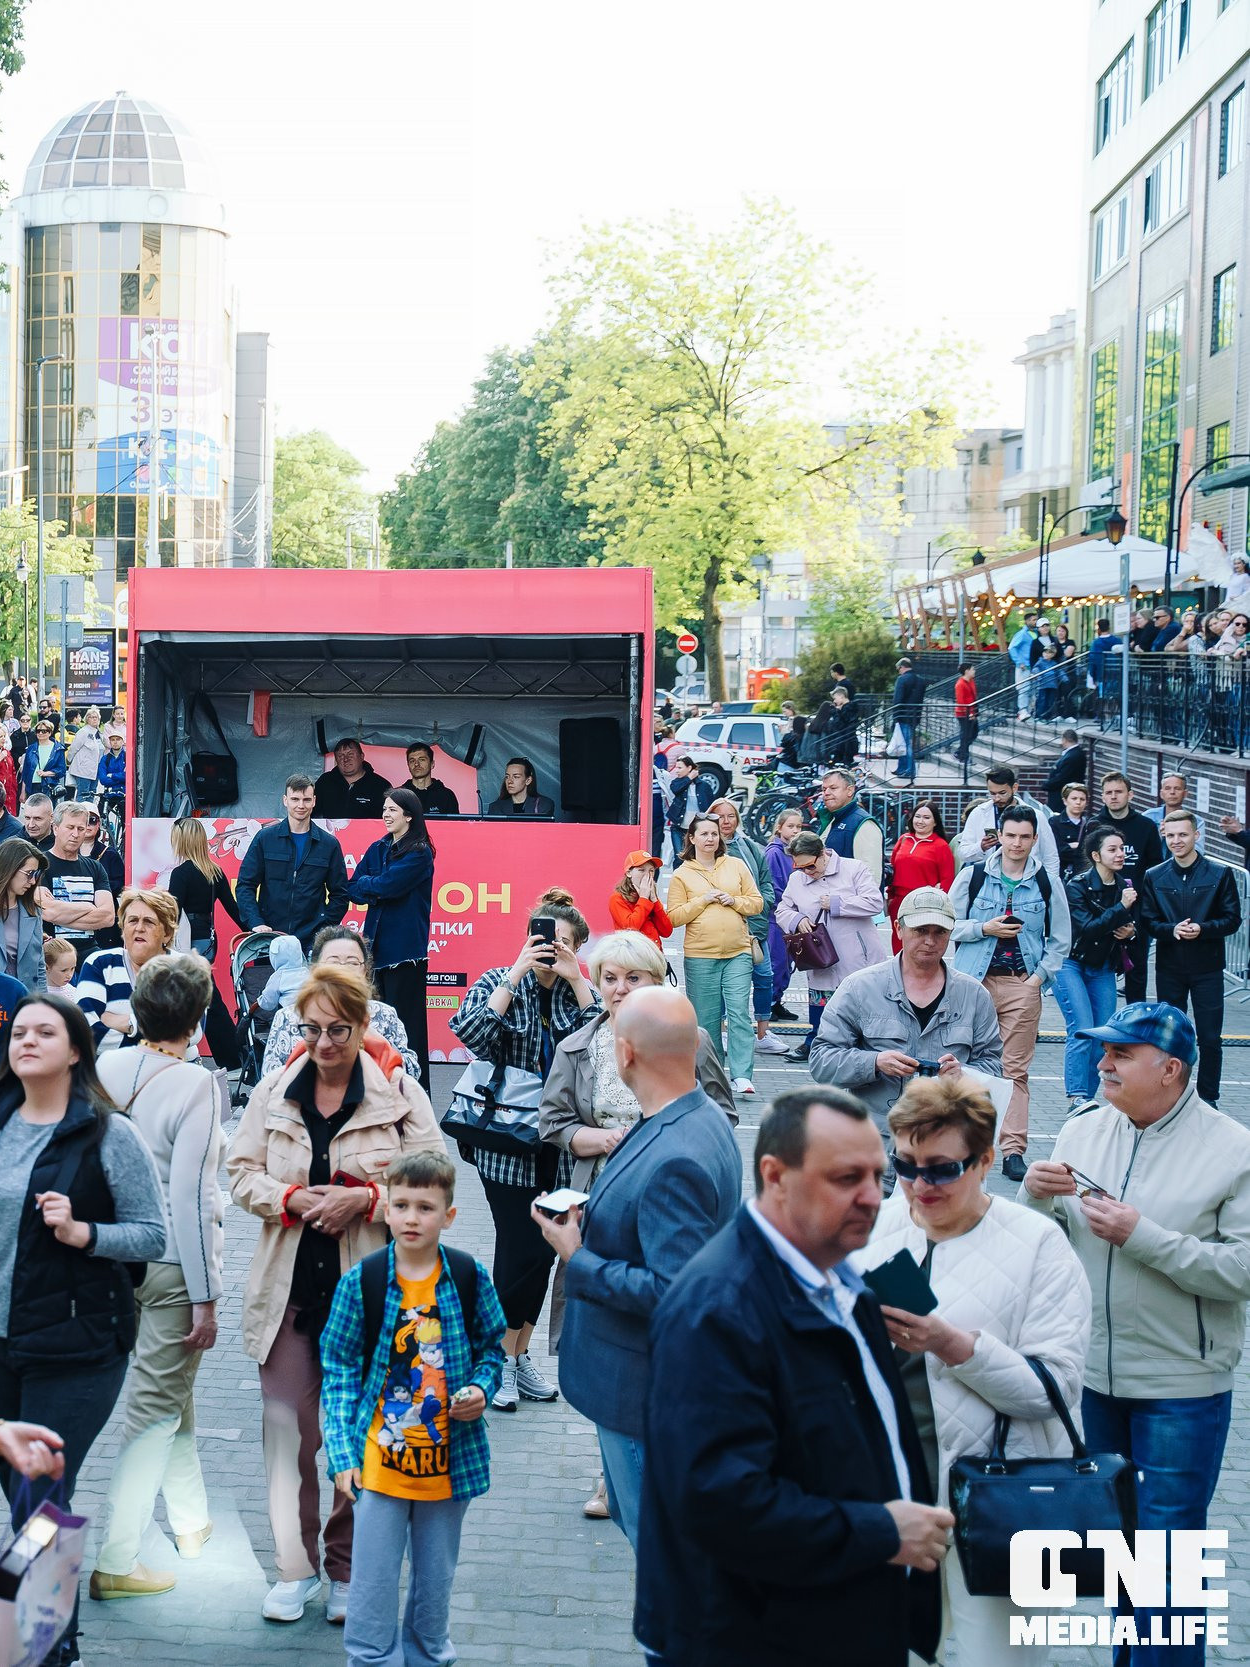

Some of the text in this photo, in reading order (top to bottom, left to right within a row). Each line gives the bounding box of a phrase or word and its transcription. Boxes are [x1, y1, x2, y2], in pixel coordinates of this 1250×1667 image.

[131, 396, 151, 423] 3
[70, 650, 109, 663] HANS
[70, 662, 110, 671] ZIMMER'S
[430, 921, 473, 936] ПКИ
[440, 974, 457, 982] ГОШ
[382, 1446, 449, 1475] NARU
